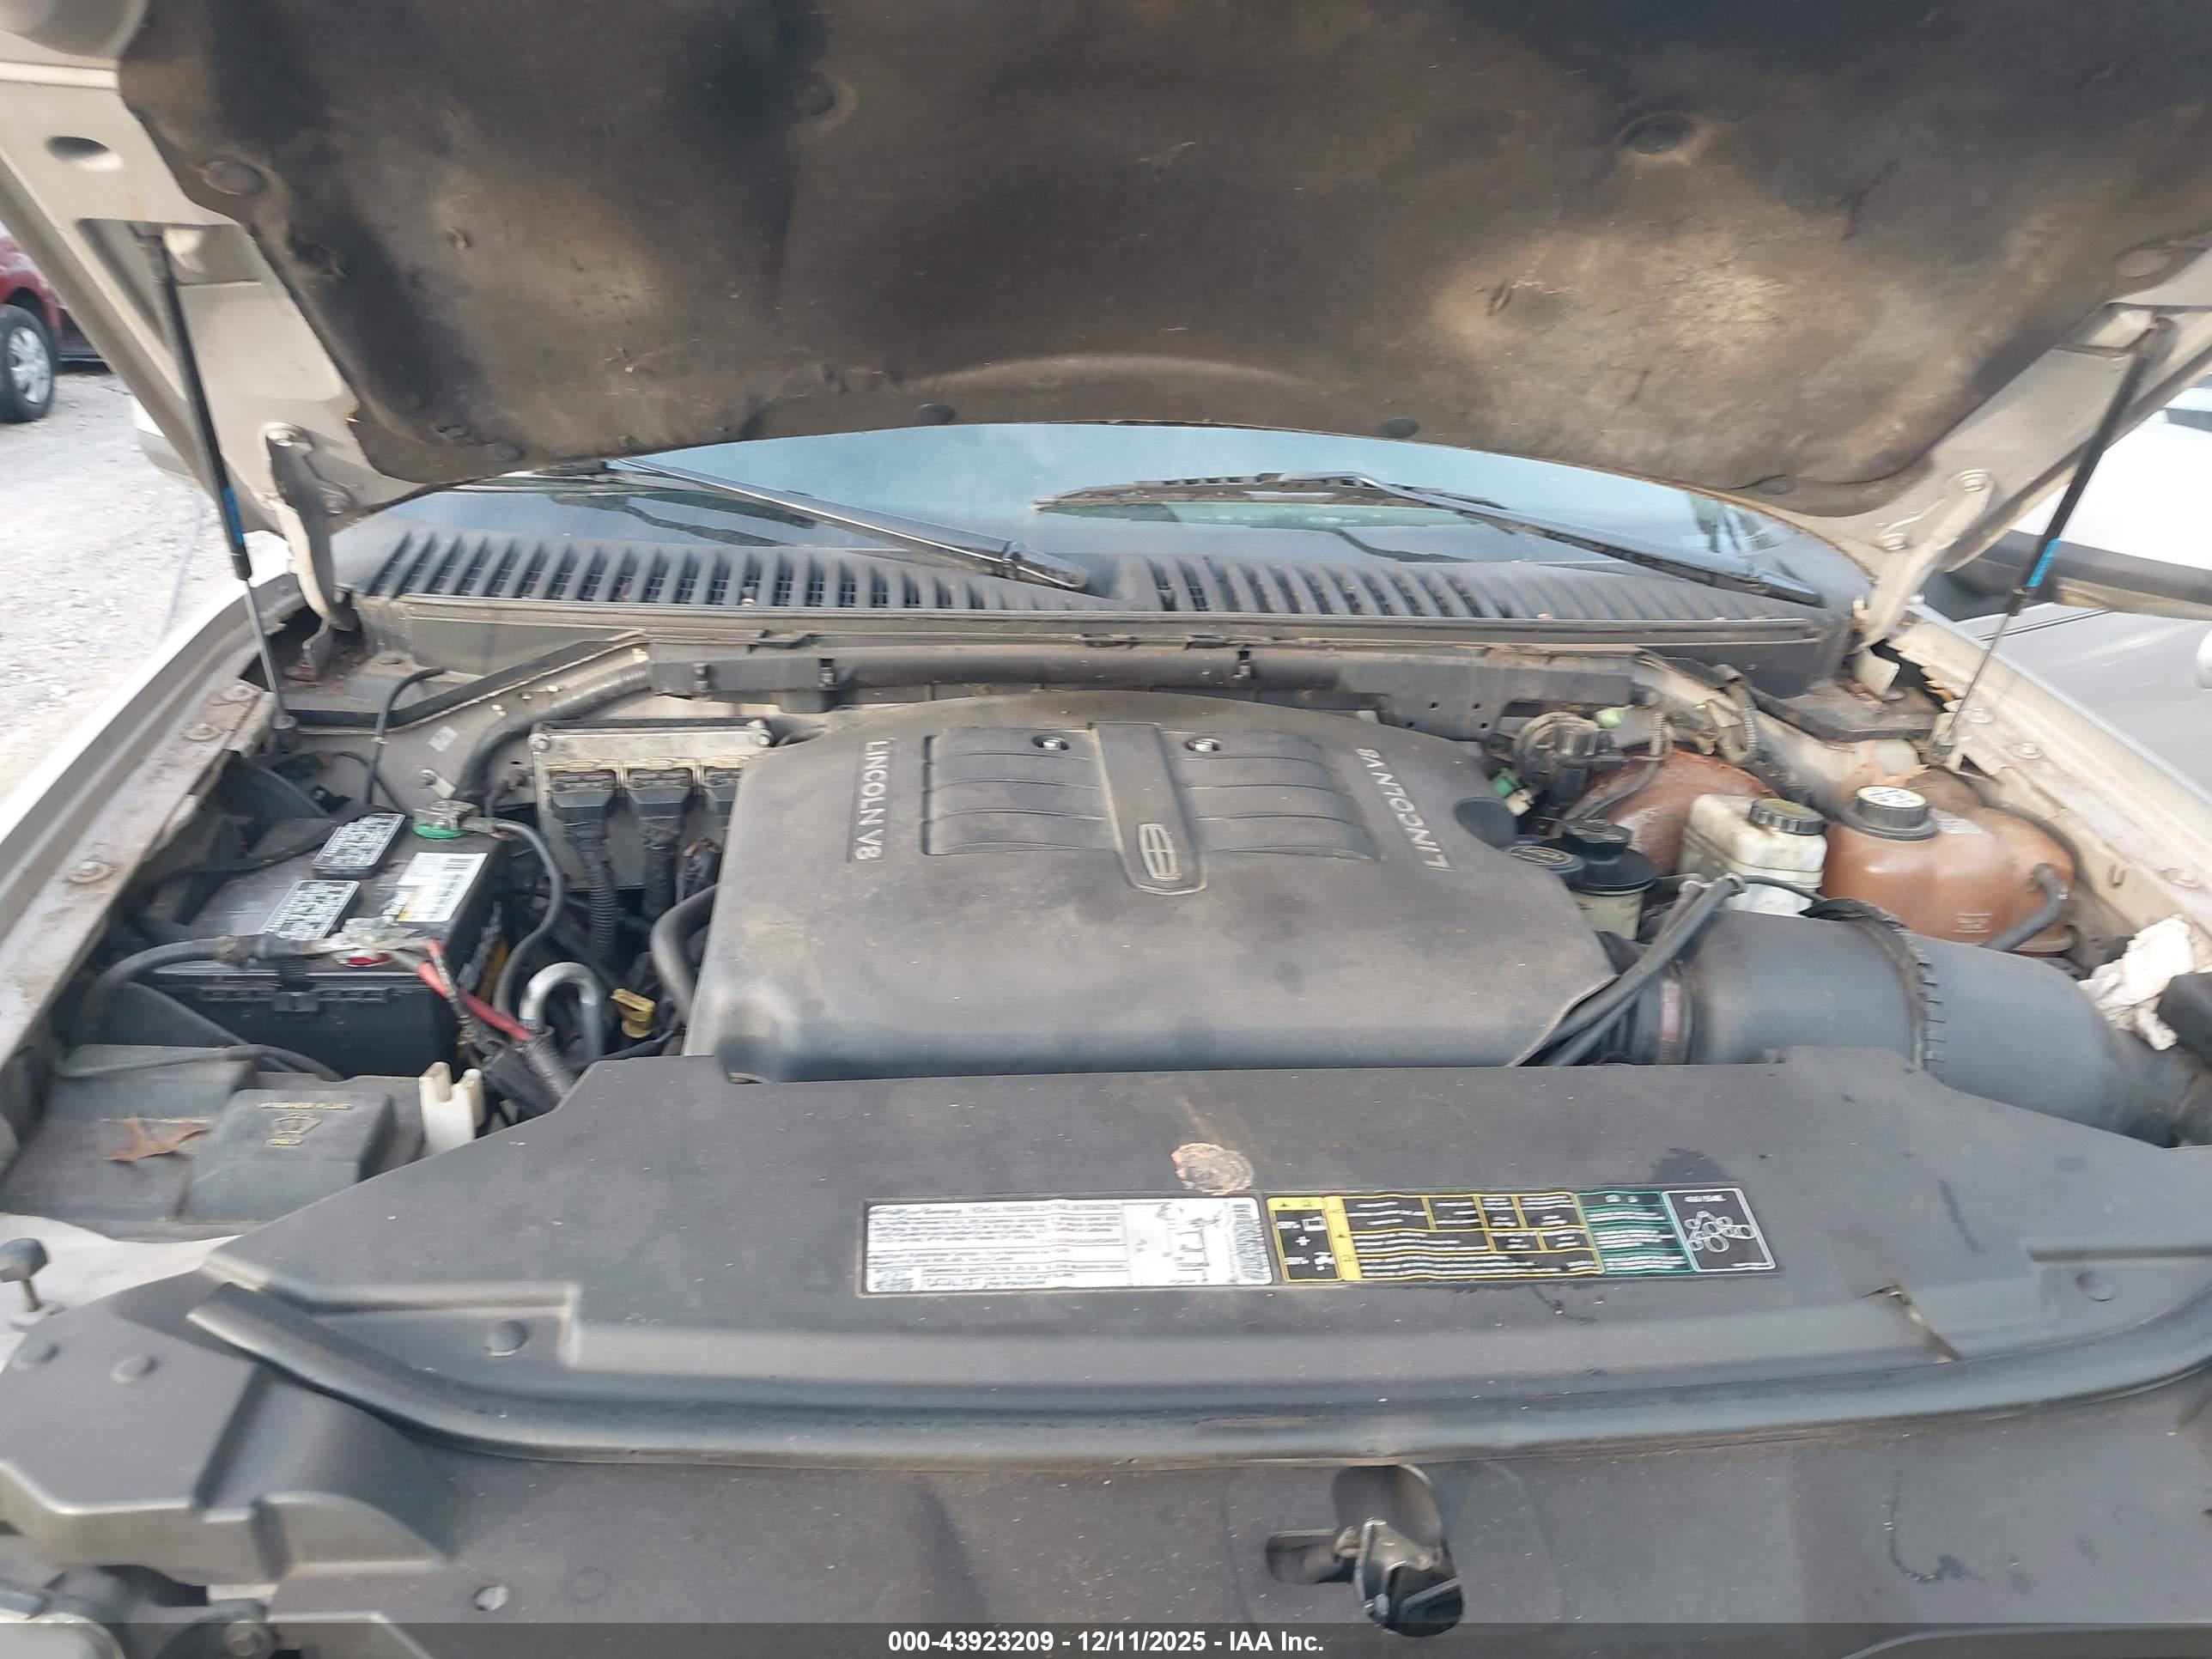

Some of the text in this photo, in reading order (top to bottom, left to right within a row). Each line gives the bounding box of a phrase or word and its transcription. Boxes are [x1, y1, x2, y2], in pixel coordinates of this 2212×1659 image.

[855, 739, 890, 860] LINCOLN V8
[1371, 772, 1450, 868] LINCOLN
